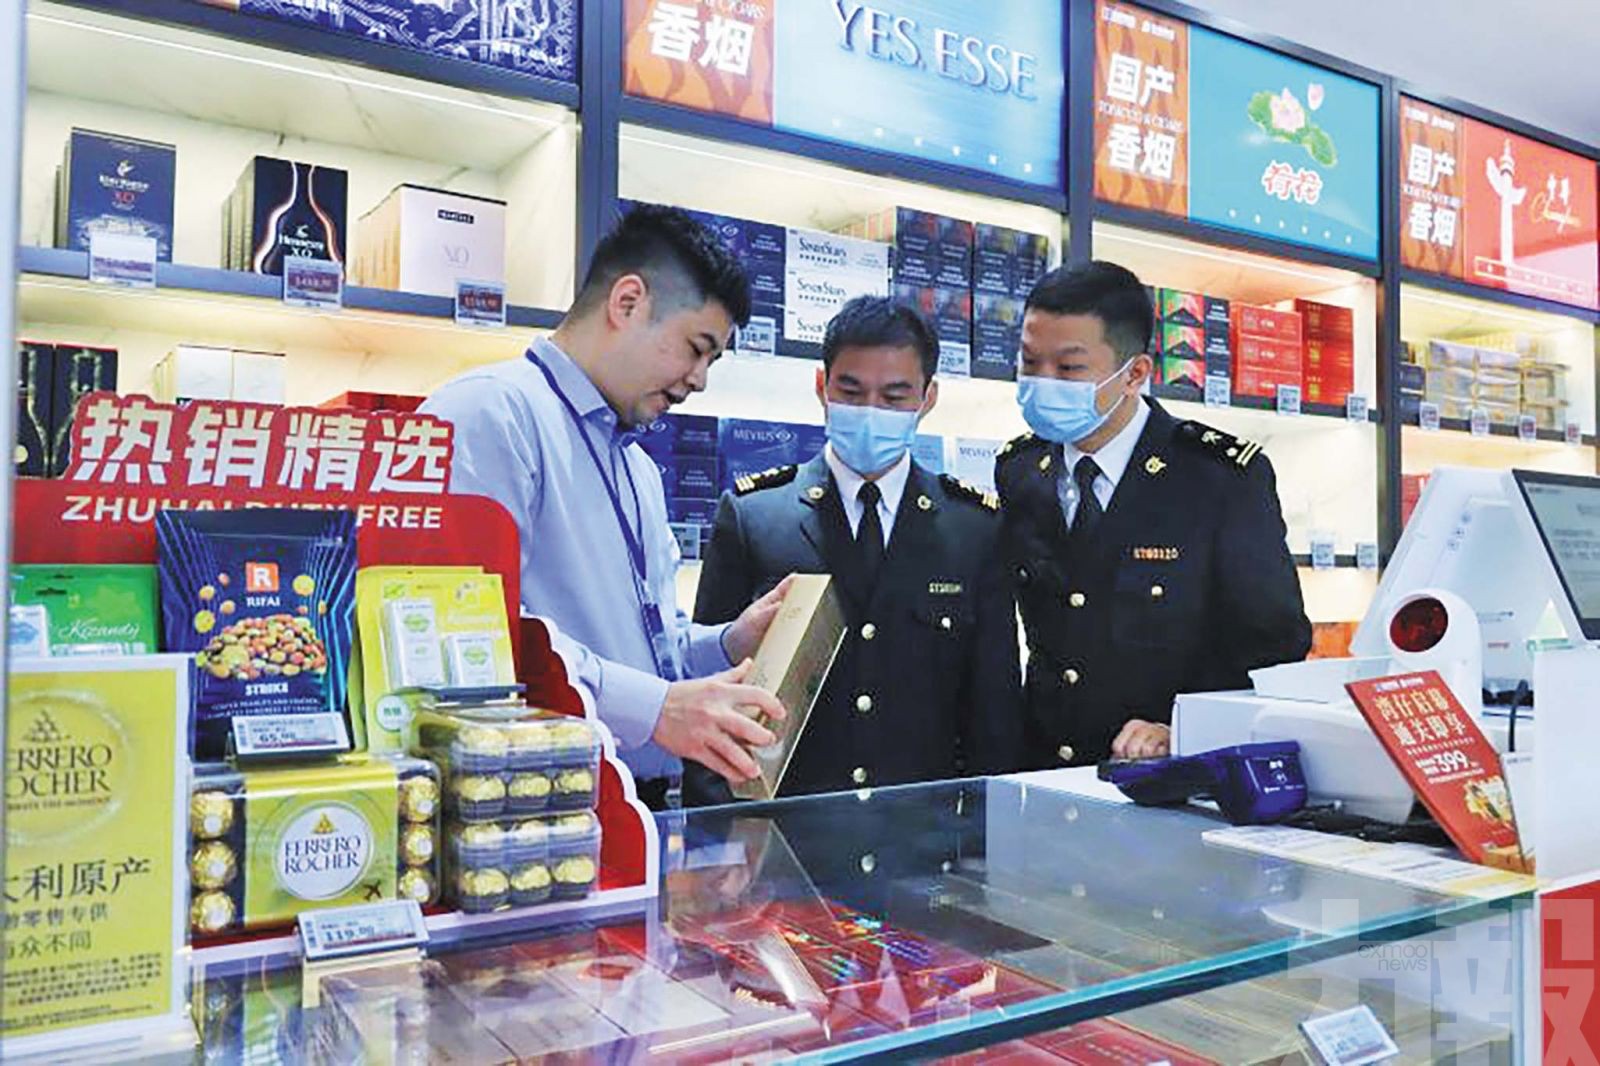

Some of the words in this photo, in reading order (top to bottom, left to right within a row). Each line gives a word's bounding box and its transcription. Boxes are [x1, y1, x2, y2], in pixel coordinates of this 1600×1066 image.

[646, 2, 755, 77] 香烟
[934, 27, 1039, 101] ESSE
[1106, 53, 1176, 108] 国产
[1107, 121, 1177, 179] 香烟
[1408, 142, 1456, 189] 国产
[1260, 159, 1324, 206] 荷花
[1409, 200, 1457, 249] 香烟
[73, 398, 449, 495] 热销精选
[358, 503, 444, 530] FREE
[253, 566, 274, 590] R
[8, 744, 112, 771] RRERO
[1436, 751, 1469, 774] 399
[284, 851, 360, 874] ROCHER
[285, 835, 361, 857] FERRERO
